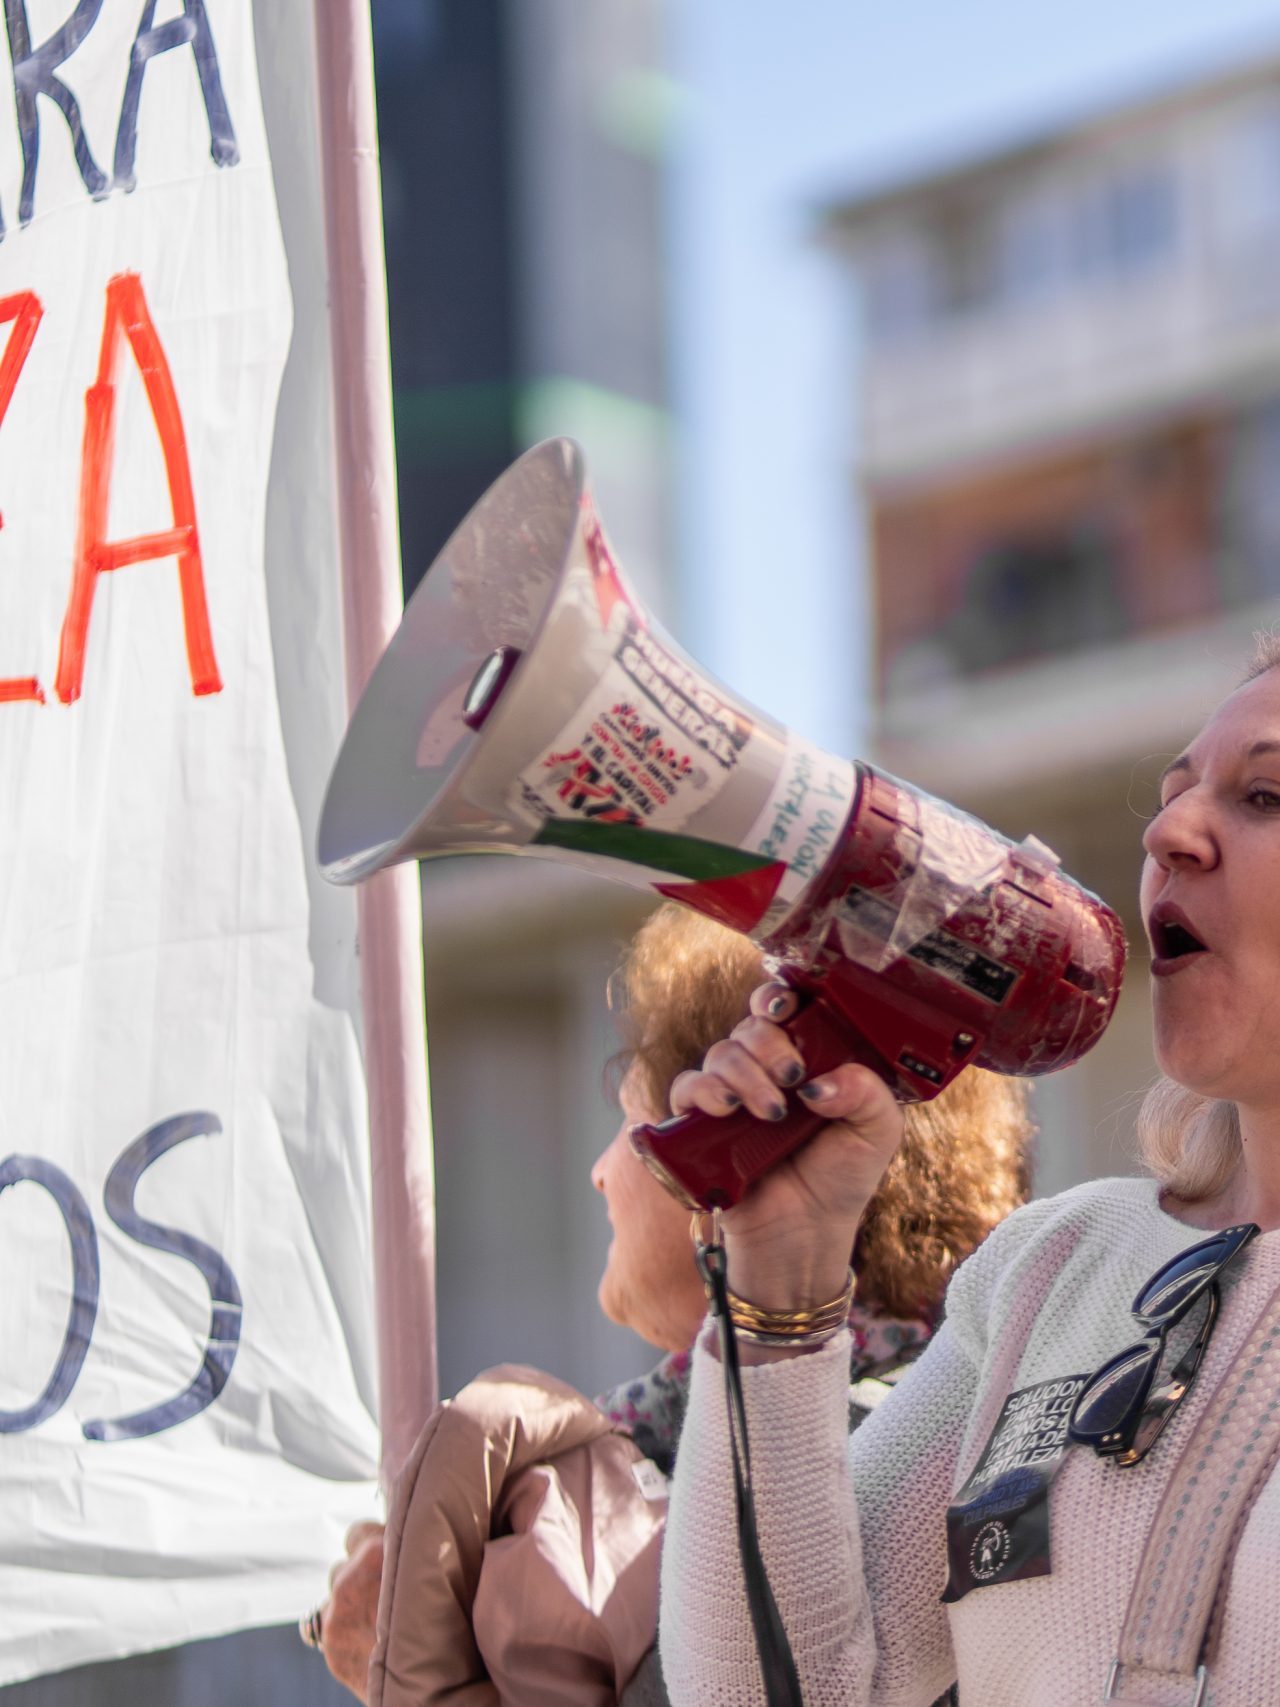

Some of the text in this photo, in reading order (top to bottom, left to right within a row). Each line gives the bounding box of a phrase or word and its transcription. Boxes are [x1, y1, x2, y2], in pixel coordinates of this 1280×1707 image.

[633, 627, 738, 735] HUELGA
[622, 645, 736, 766] GENERAL
[990, 1415, 1058, 1451] VECINOS
[1004, 1400, 1048, 1430] PARA
[1006, 1433, 1039, 1456] UVA
[1039, 1429, 1067, 1448] DE
[969, 1446, 1065, 1488] HORTALEZA
